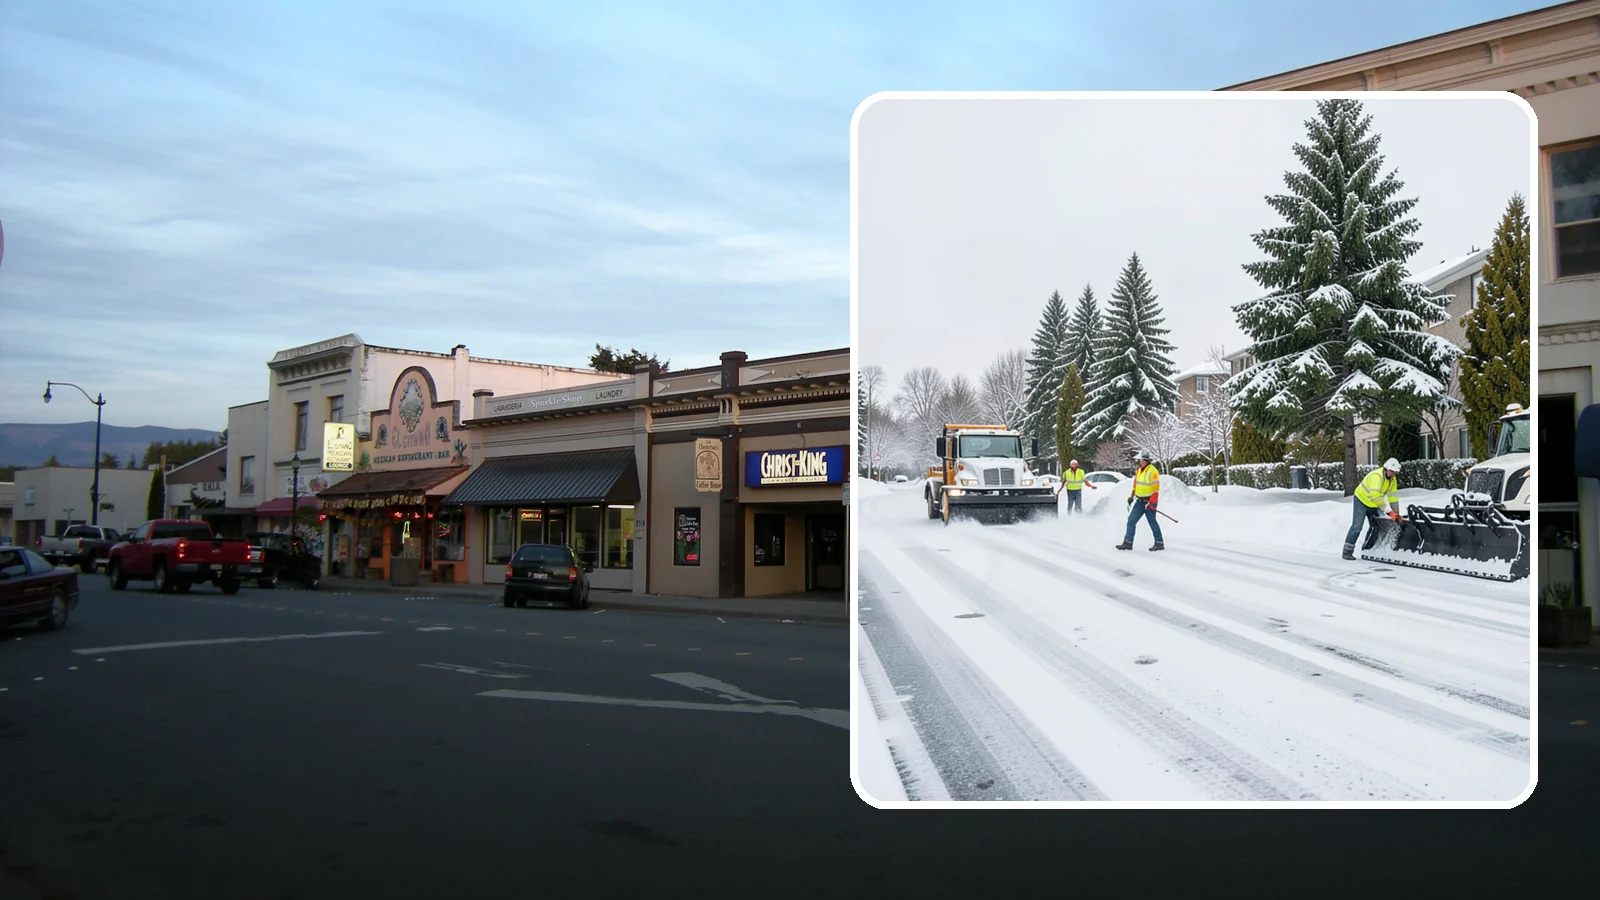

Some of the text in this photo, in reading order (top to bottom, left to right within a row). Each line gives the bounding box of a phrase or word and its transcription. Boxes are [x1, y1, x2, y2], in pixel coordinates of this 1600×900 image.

[595, 389, 623, 400] LAUNDRY
[493, 402, 522, 413] LAVANDERIA
[531, 394, 582, 409] Sparkle Shop
[373, 454, 396, 464] MEXICAN
[397, 451, 433, 462] RESTAURANT
[438, 450, 450, 459] BAR
[761, 449, 827, 478] CHRIST KING
[696, 480, 722, 489] Coffee House
